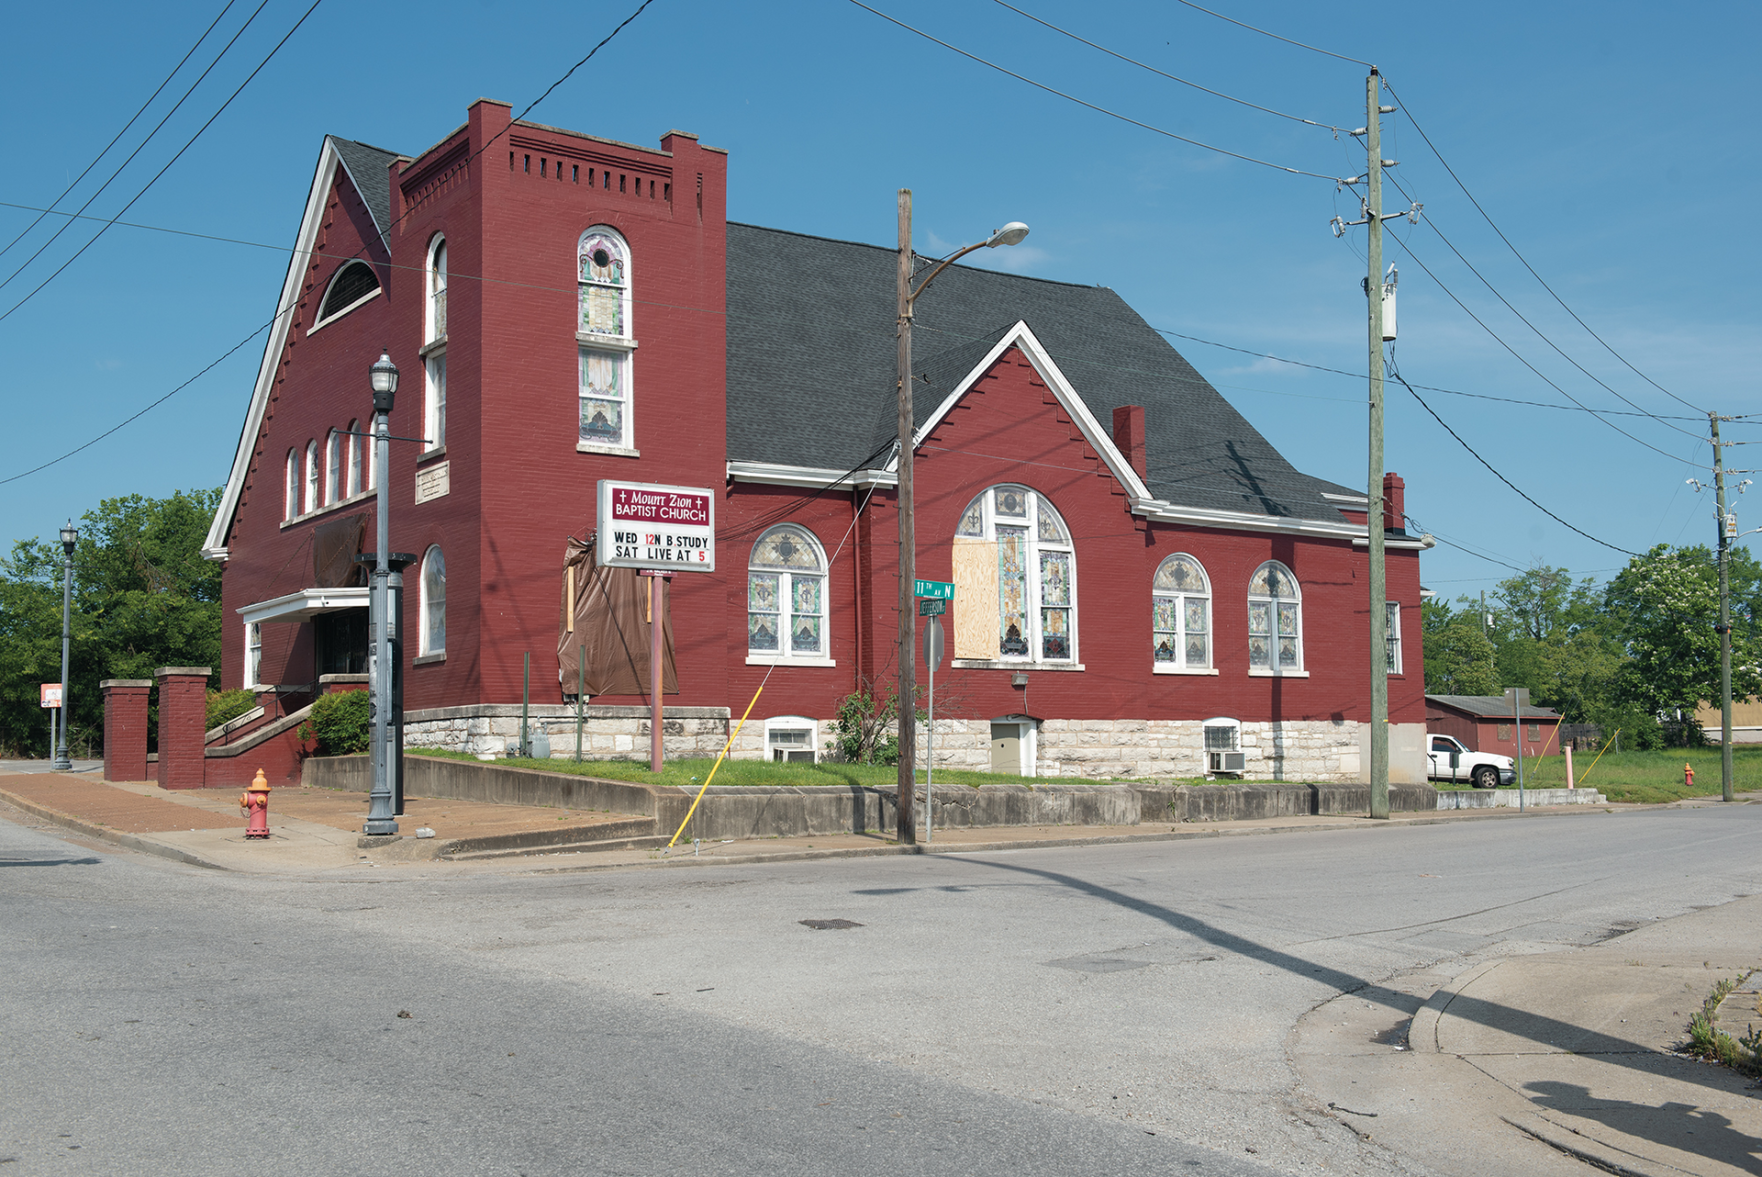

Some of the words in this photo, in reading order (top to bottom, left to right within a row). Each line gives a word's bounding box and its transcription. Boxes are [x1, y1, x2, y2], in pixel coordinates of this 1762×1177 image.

[631, 491, 666, 506] Mount
[669, 494, 692, 508] Zion
[615, 504, 656, 517] BAPTIST
[660, 507, 706, 521] CHURCH
[614, 531, 638, 544] WED
[645, 533, 661, 546] 12N
[616, 545, 638, 558] SAT
[648, 547, 672, 560] LIVE
[677, 549, 691, 561] AT
[698, 551, 705, 562] 5
[944, 585, 951, 598] N
[920, 600, 943, 614] JEFFERSON
